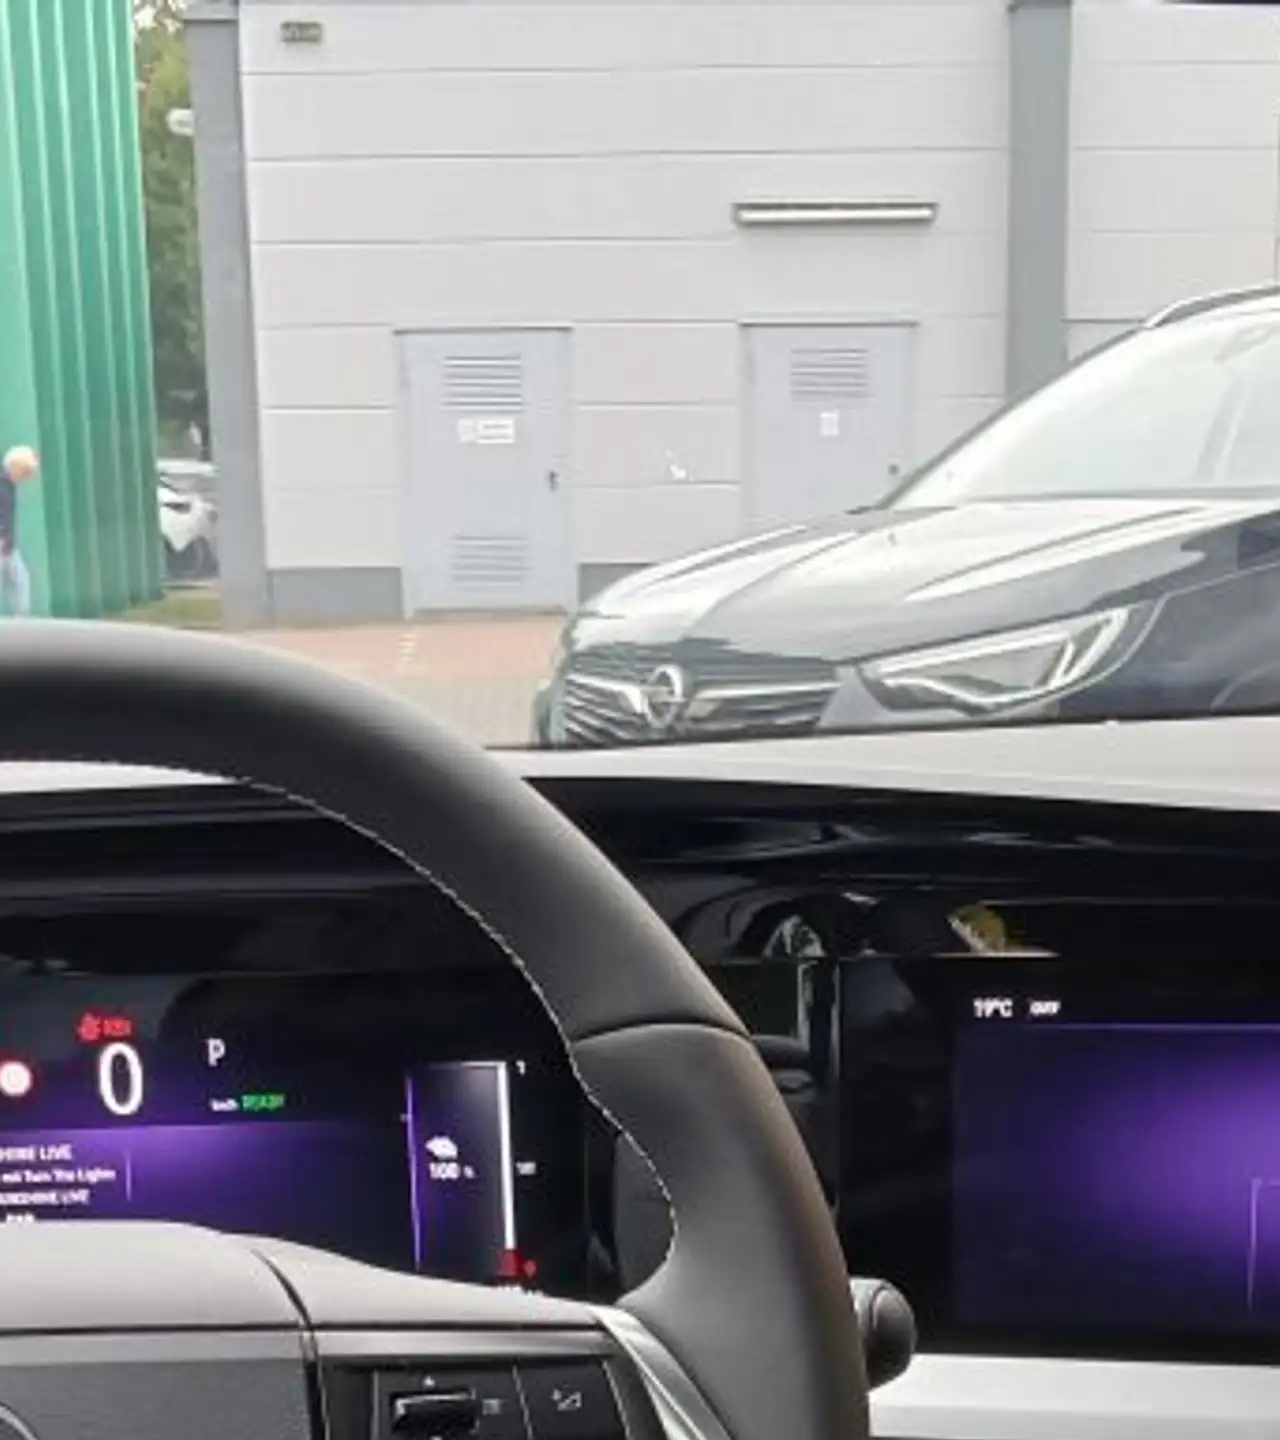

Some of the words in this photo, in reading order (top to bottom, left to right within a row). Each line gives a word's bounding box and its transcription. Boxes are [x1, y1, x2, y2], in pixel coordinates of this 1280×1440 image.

[207, 1038, 226, 1066] P
[99, 1042, 143, 1115] 0
[40, 1144, 72, 1160] LIVE
[24, 1169, 52, 1183] Turn
[54, 1168, 74, 1182] The
[77, 1167, 116, 1184] Lights
[429, 1162, 461, 1180] 100
[59, 1189, 90, 1205] LIVE
